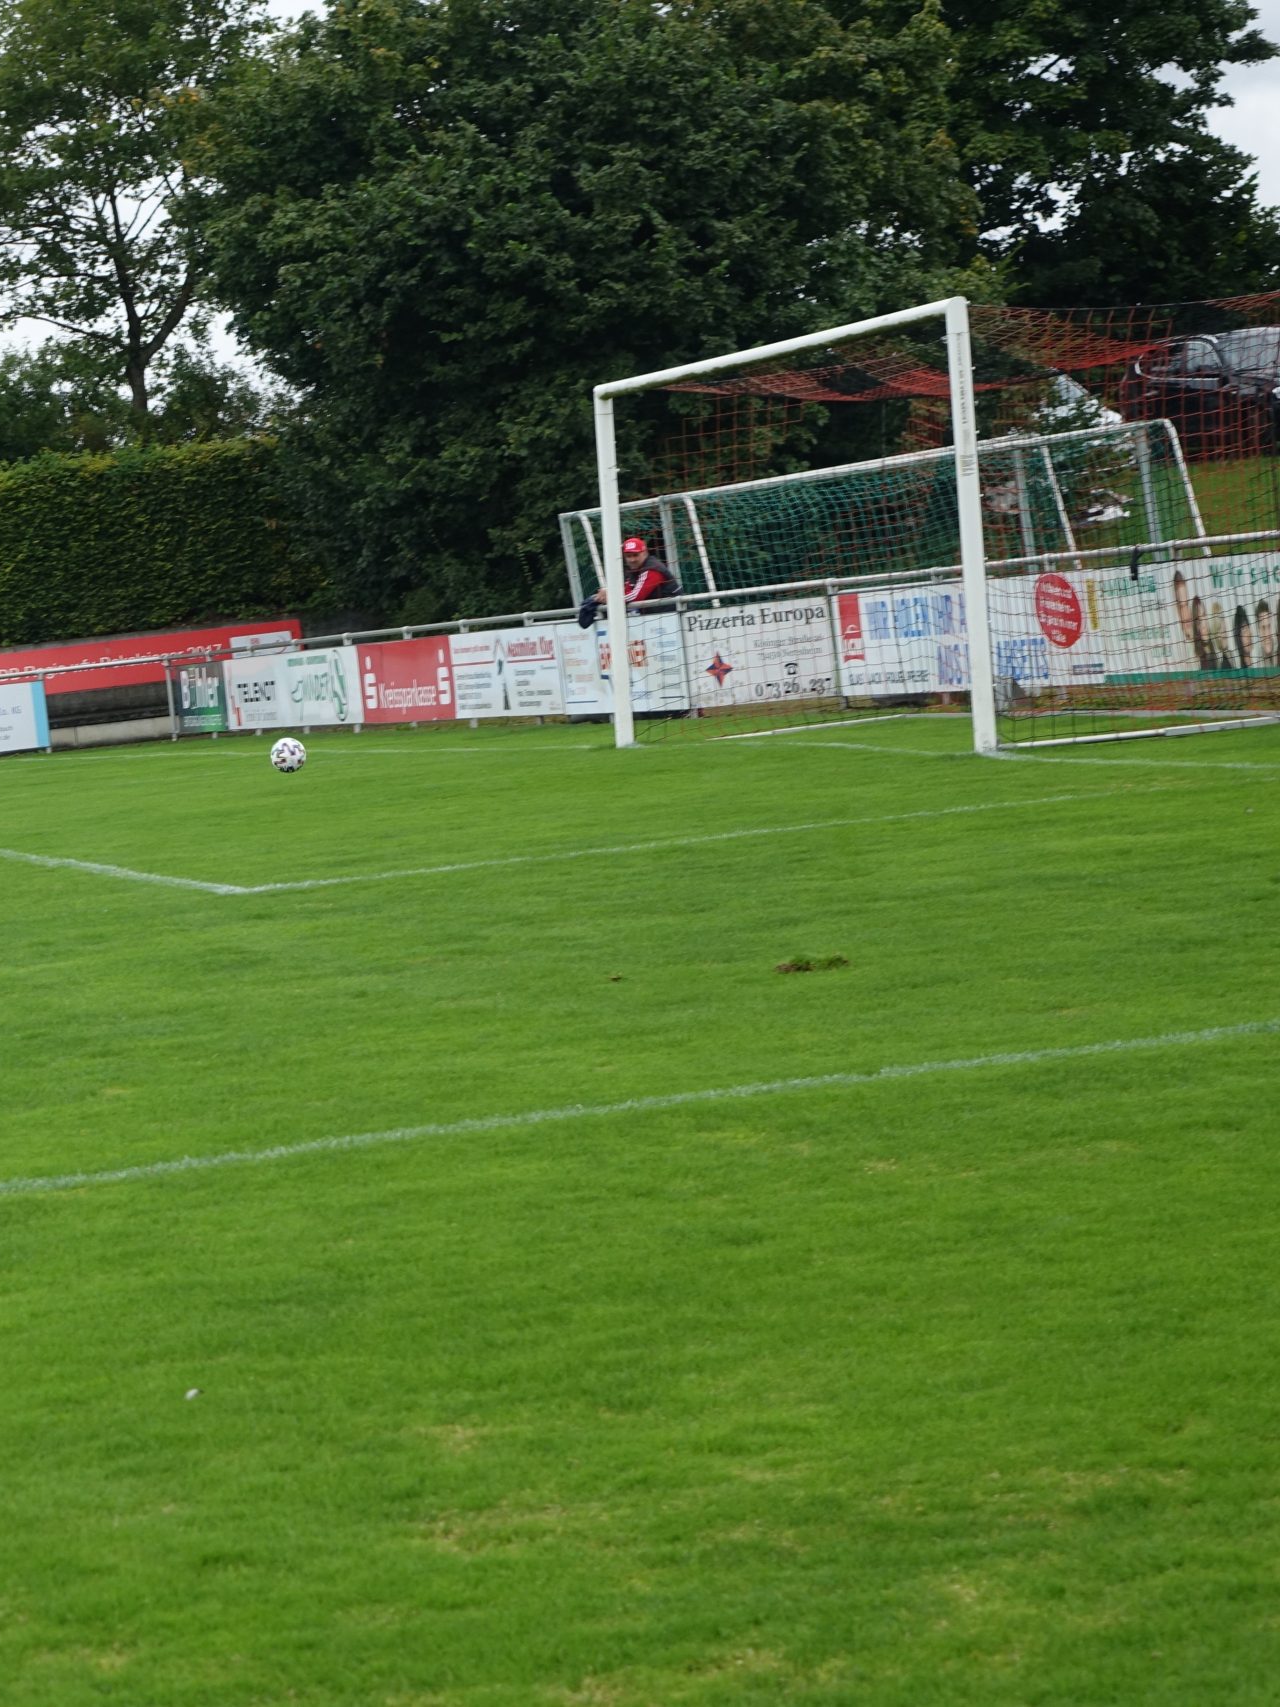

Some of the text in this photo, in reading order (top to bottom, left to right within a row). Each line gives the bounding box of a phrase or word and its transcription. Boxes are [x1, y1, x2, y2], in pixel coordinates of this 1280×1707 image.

[687, 606, 826, 632] Pizzeria Europa
[377, 678, 437, 715] Kreissparkasse
